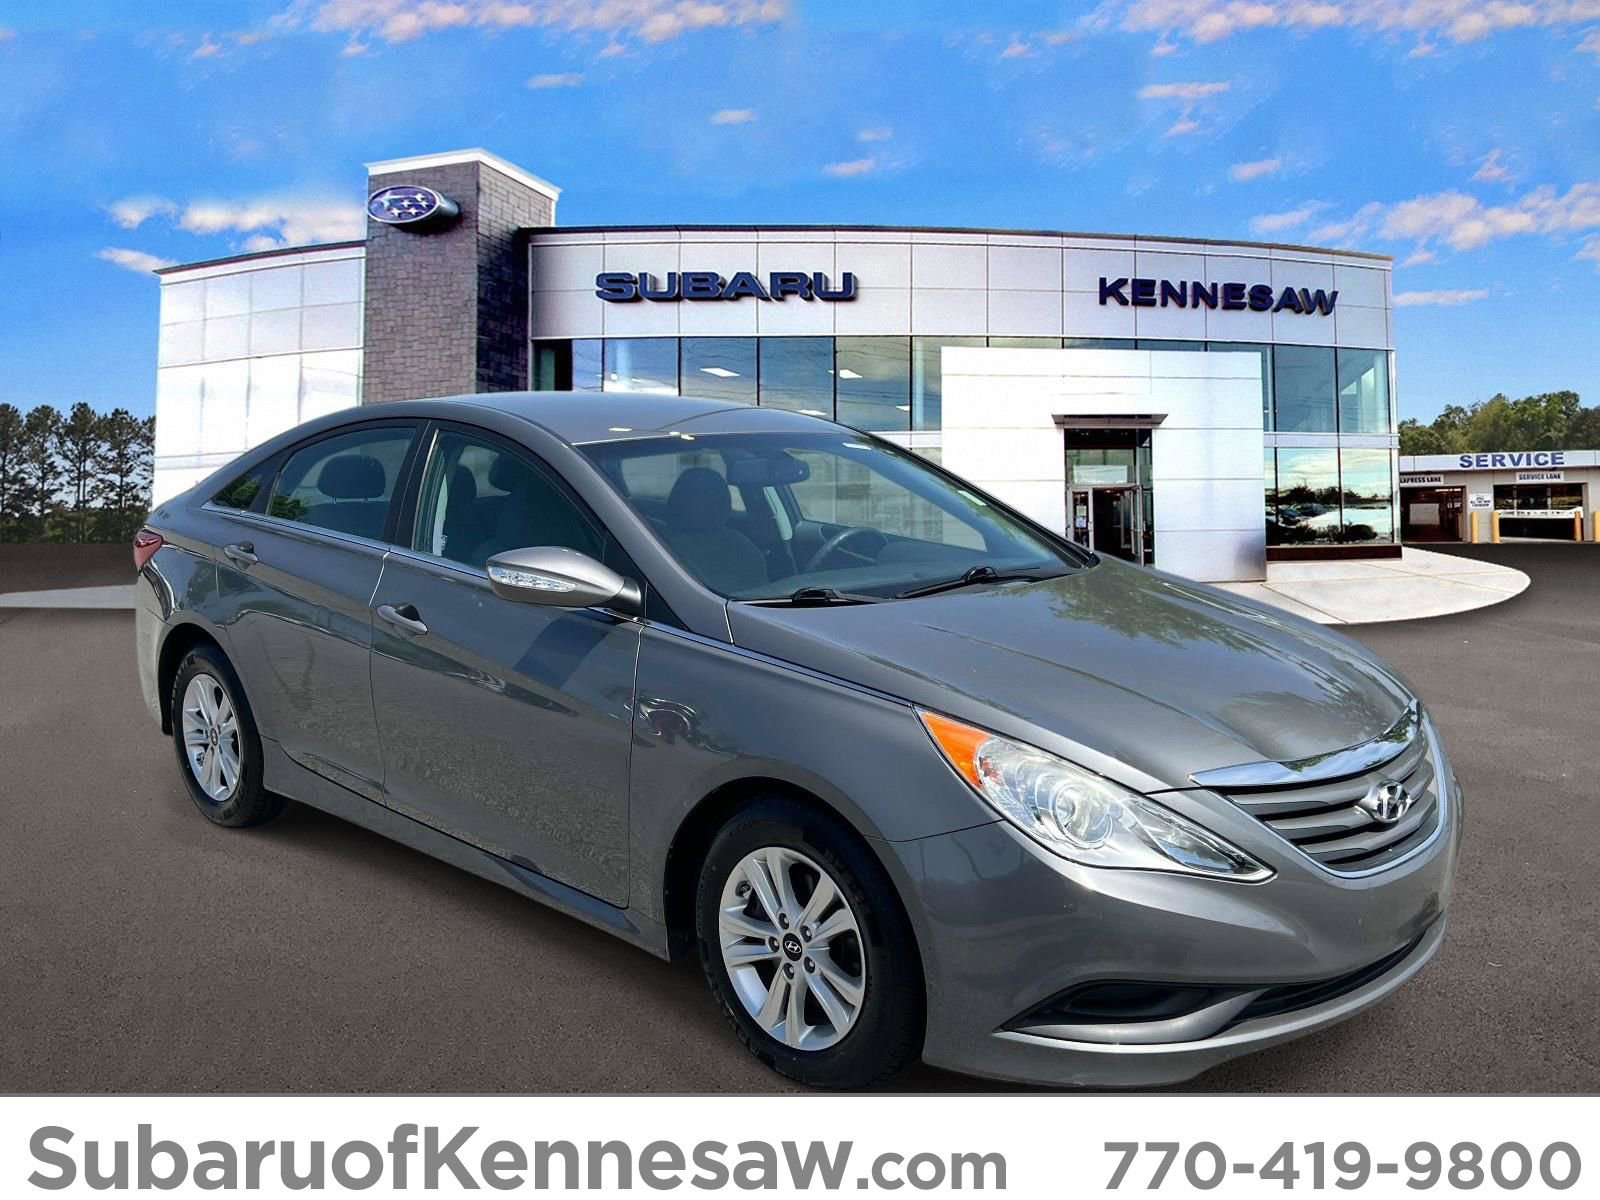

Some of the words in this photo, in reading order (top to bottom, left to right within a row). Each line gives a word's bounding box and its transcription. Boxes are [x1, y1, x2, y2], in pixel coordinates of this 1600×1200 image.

[595, 271, 858, 303] SUBARU
[1098, 277, 1338, 316] KENNESAW
[1459, 452, 1565, 468] SERVICE
